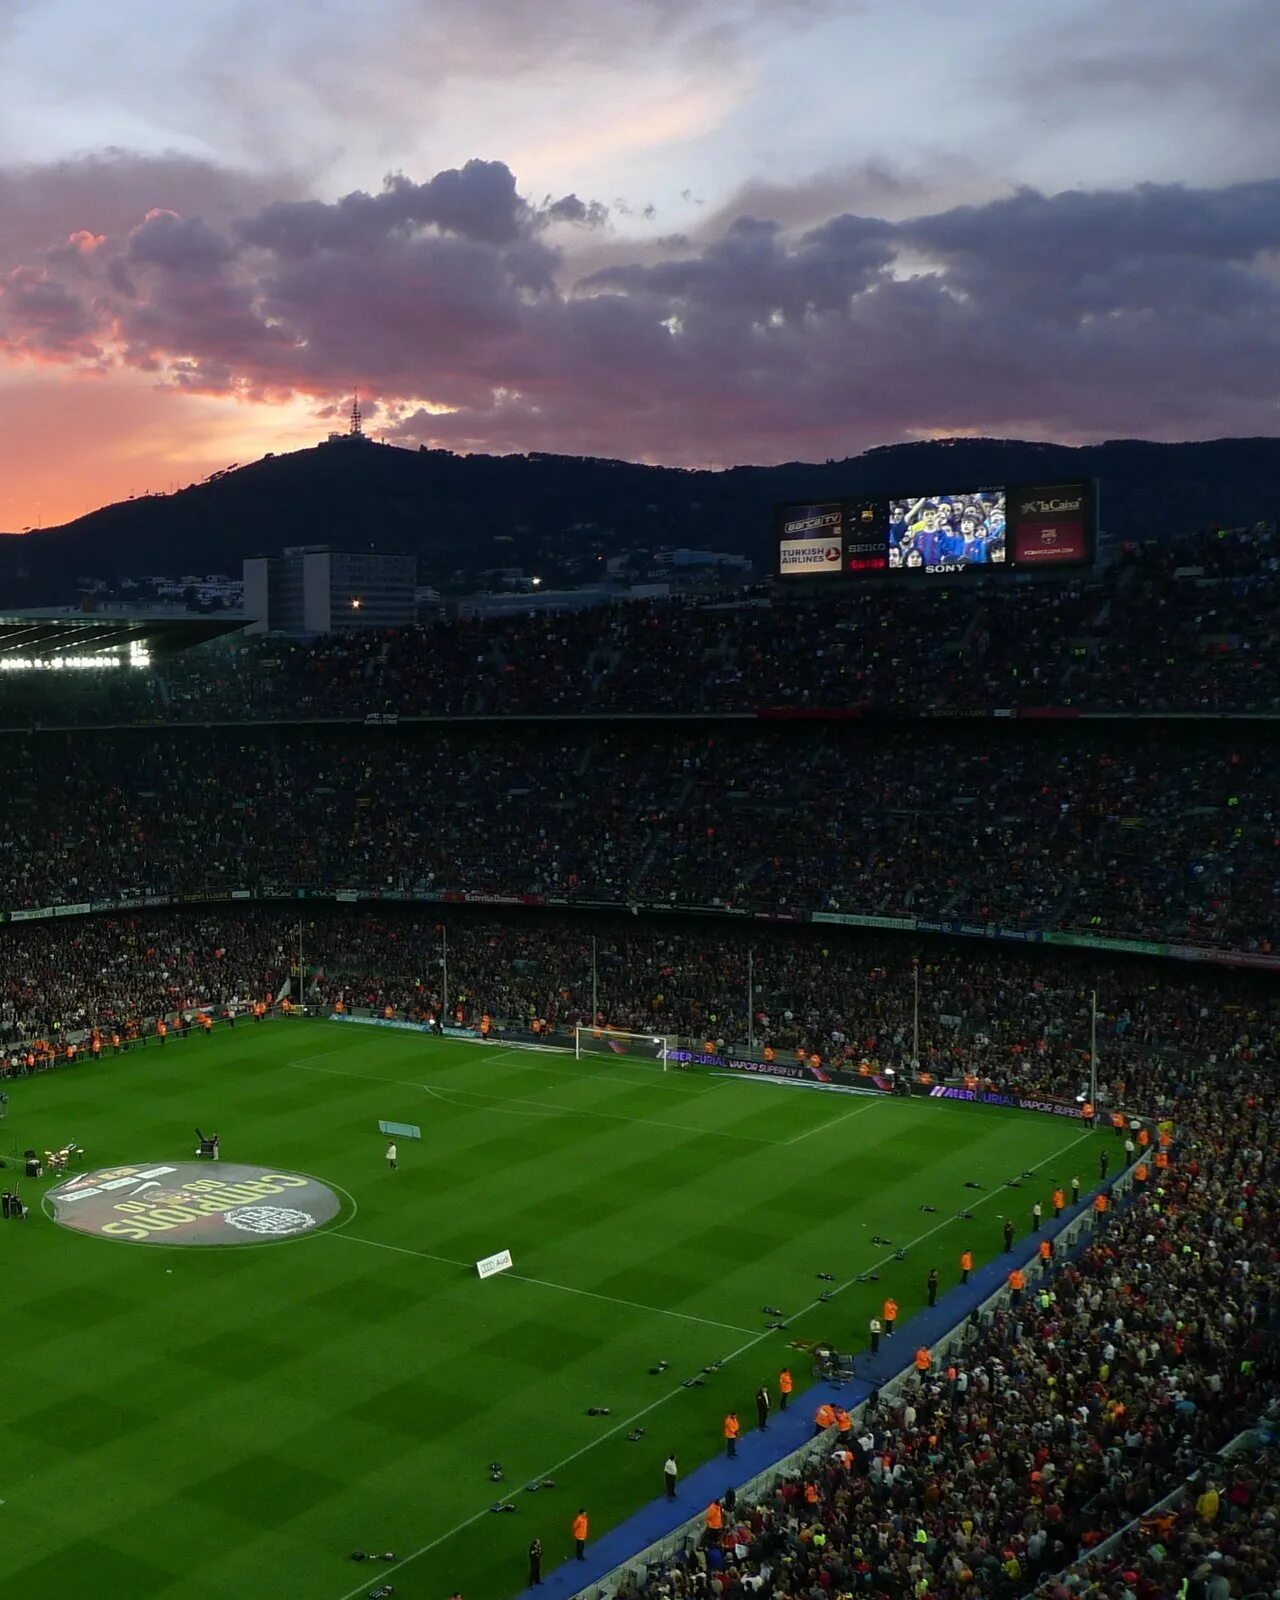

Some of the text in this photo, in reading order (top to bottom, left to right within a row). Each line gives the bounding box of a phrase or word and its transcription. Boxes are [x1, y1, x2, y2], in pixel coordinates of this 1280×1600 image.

[823, 514, 839, 523] TV
[782, 547, 824, 557] TURKISH
[848, 543, 886, 553] SEIKO
[782, 556, 825, 564] AIRLINES
[925, 563, 966, 574] SONY
[729, 1060, 758, 1071] VAPOR
[1020, 1099, 1053, 1112] VAPOR
[101, 1174, 308, 1239] CAMPIONS
